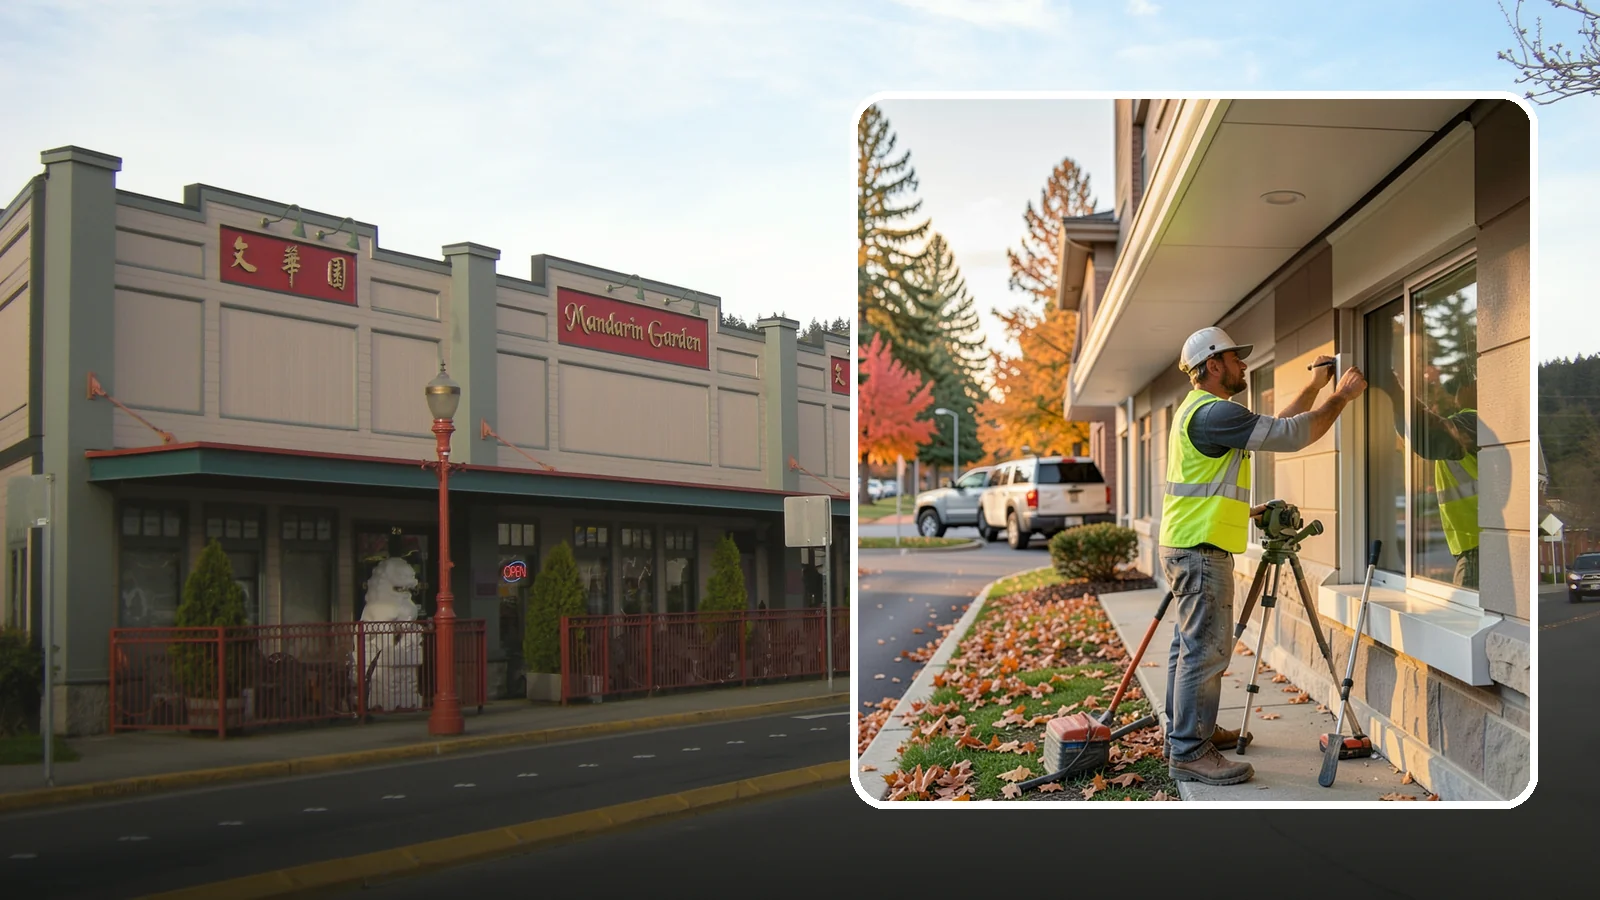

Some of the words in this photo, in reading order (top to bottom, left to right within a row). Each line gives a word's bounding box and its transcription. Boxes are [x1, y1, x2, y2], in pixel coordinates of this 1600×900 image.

[564, 302, 644, 341] Mandarin
[648, 320, 701, 352] Garden
[503, 565, 527, 578] OPEN
